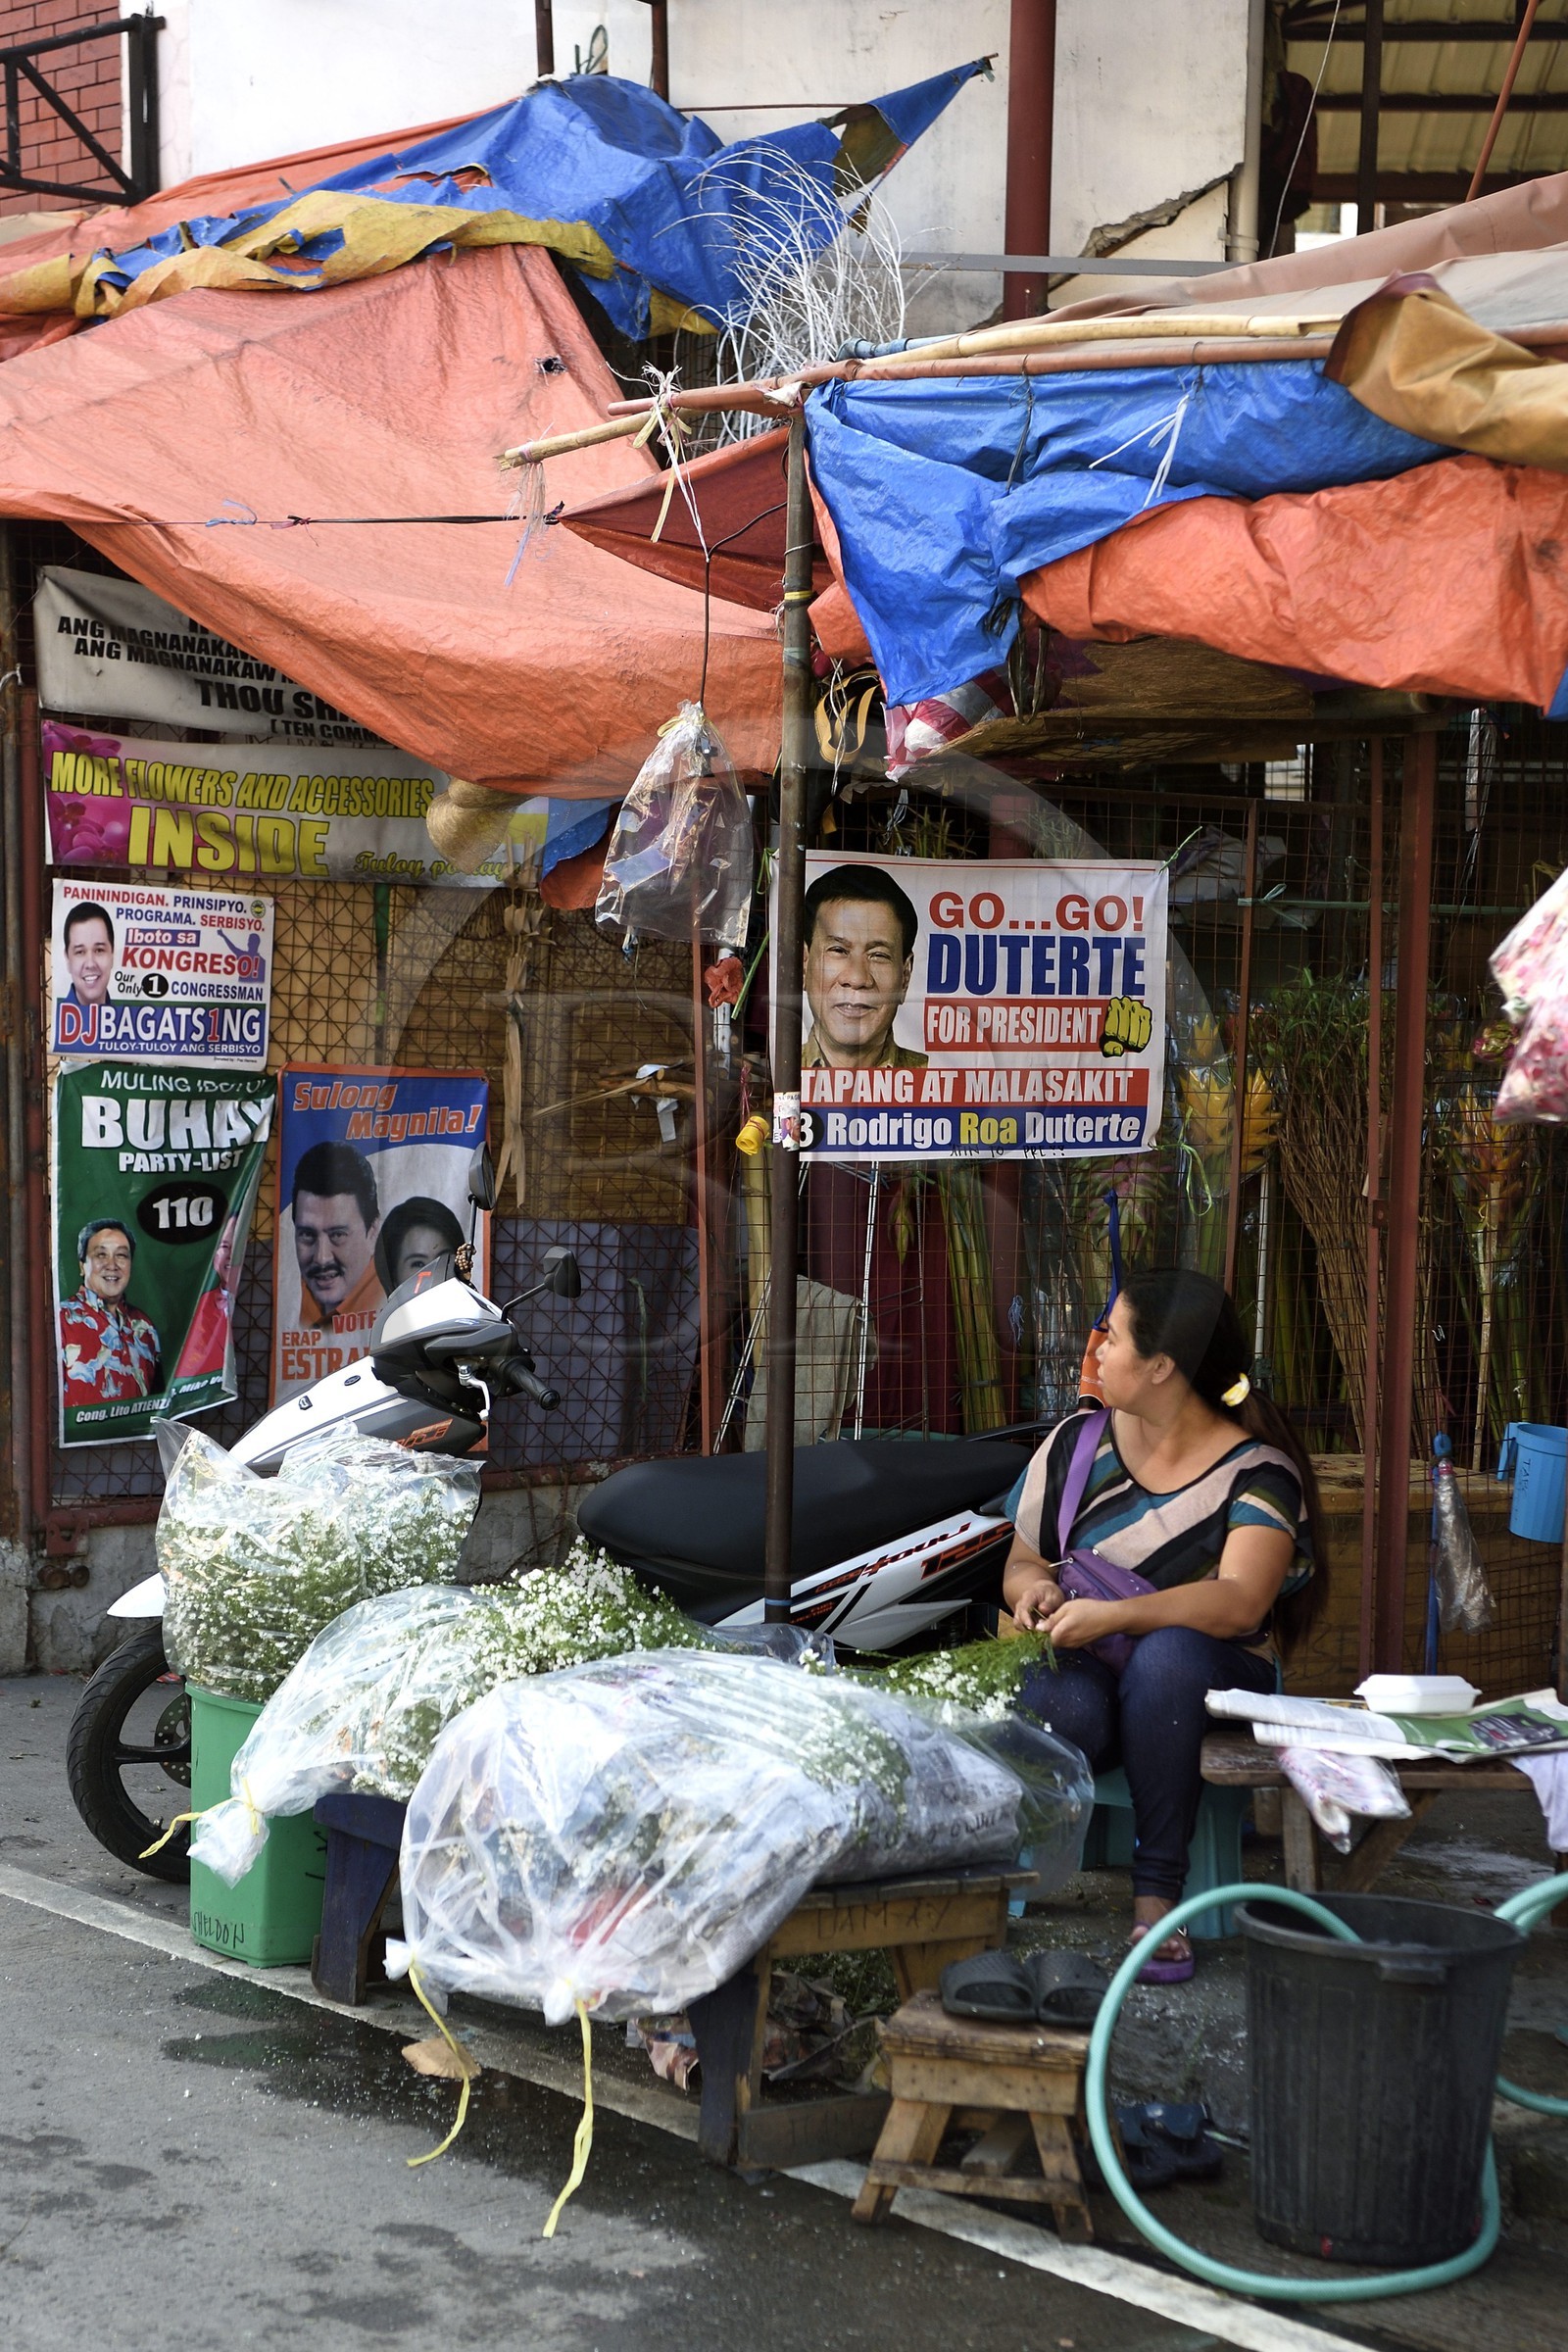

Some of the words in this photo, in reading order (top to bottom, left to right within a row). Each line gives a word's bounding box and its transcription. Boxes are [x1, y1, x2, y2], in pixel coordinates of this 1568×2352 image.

[57, 615, 105, 639] ANG
[74, 637, 122, 661] ANG
[126, 645, 276, 683] MAGNANAKAW
[194, 678, 284, 715] THOU
[281, 720, 315, 738] TEN
[319, 722, 384, 742] COMM
[51, 751, 123, 798] MORE
[124, 758, 238, 808] FLOWERS
[235, 772, 293, 811] AND
[289, 774, 435, 818] ACCESSORIES
[127, 805, 330, 877] INSIDE
[354, 851, 426, 878] Tuloy
[64, 886, 169, 907] PANININDIGAN.
[173, 896, 247, 913] PRINSIPYO.
[928, 890, 1145, 932] GO...GO!
[116, 906, 196, 926] PROGRAMA.
[200, 914, 265, 932] SERBISYO.
[126, 928, 172, 945] Iboto
[176, 933, 197, 945] sa
[115, 971, 135, 982] Our
[122, 947, 260, 978] KONGRESO!
[926, 933, 1146, 996] DUTERTE
[118, 982, 142, 997] Only
[147, 976, 163, 996] 1
[172, 981, 264, 1002] CONGRESSMAN
[927, 1005, 970, 1044] FOR
[978, 1005, 1102, 1045] PRESIDENT
[99, 1042, 175, 1053] TULOY-TULOY
[180, 1044, 205, 1054] ANG
[208, 1044, 261, 1054] SERBISYO
[101, 1070, 191, 1092] MULING
[293, 1081, 398, 1111] Sulong
[801, 1068, 913, 1103] TAPANG
[919, 1069, 960, 1103] AT
[964, 1069, 1134, 1104] MALASAKIT
[81, 1095, 275, 1151] BUHAY
[345, 1104, 483, 1143] Maynila!
[826, 1112, 953, 1148] Rodrigo
[959, 1112, 1017, 1145] Roa
[1025, 1115, 1140, 1145] Duterte
[119, 1149, 243, 1172] PARTY-LIST
[152, 1197, 214, 1229] 110
[281, 1330, 321, 1348] ERAP
[280, 1347, 371, 1382] ESTRA
[76, 1408, 109, 1423] Cong.
[110, 1404, 130, 1417] Lito
